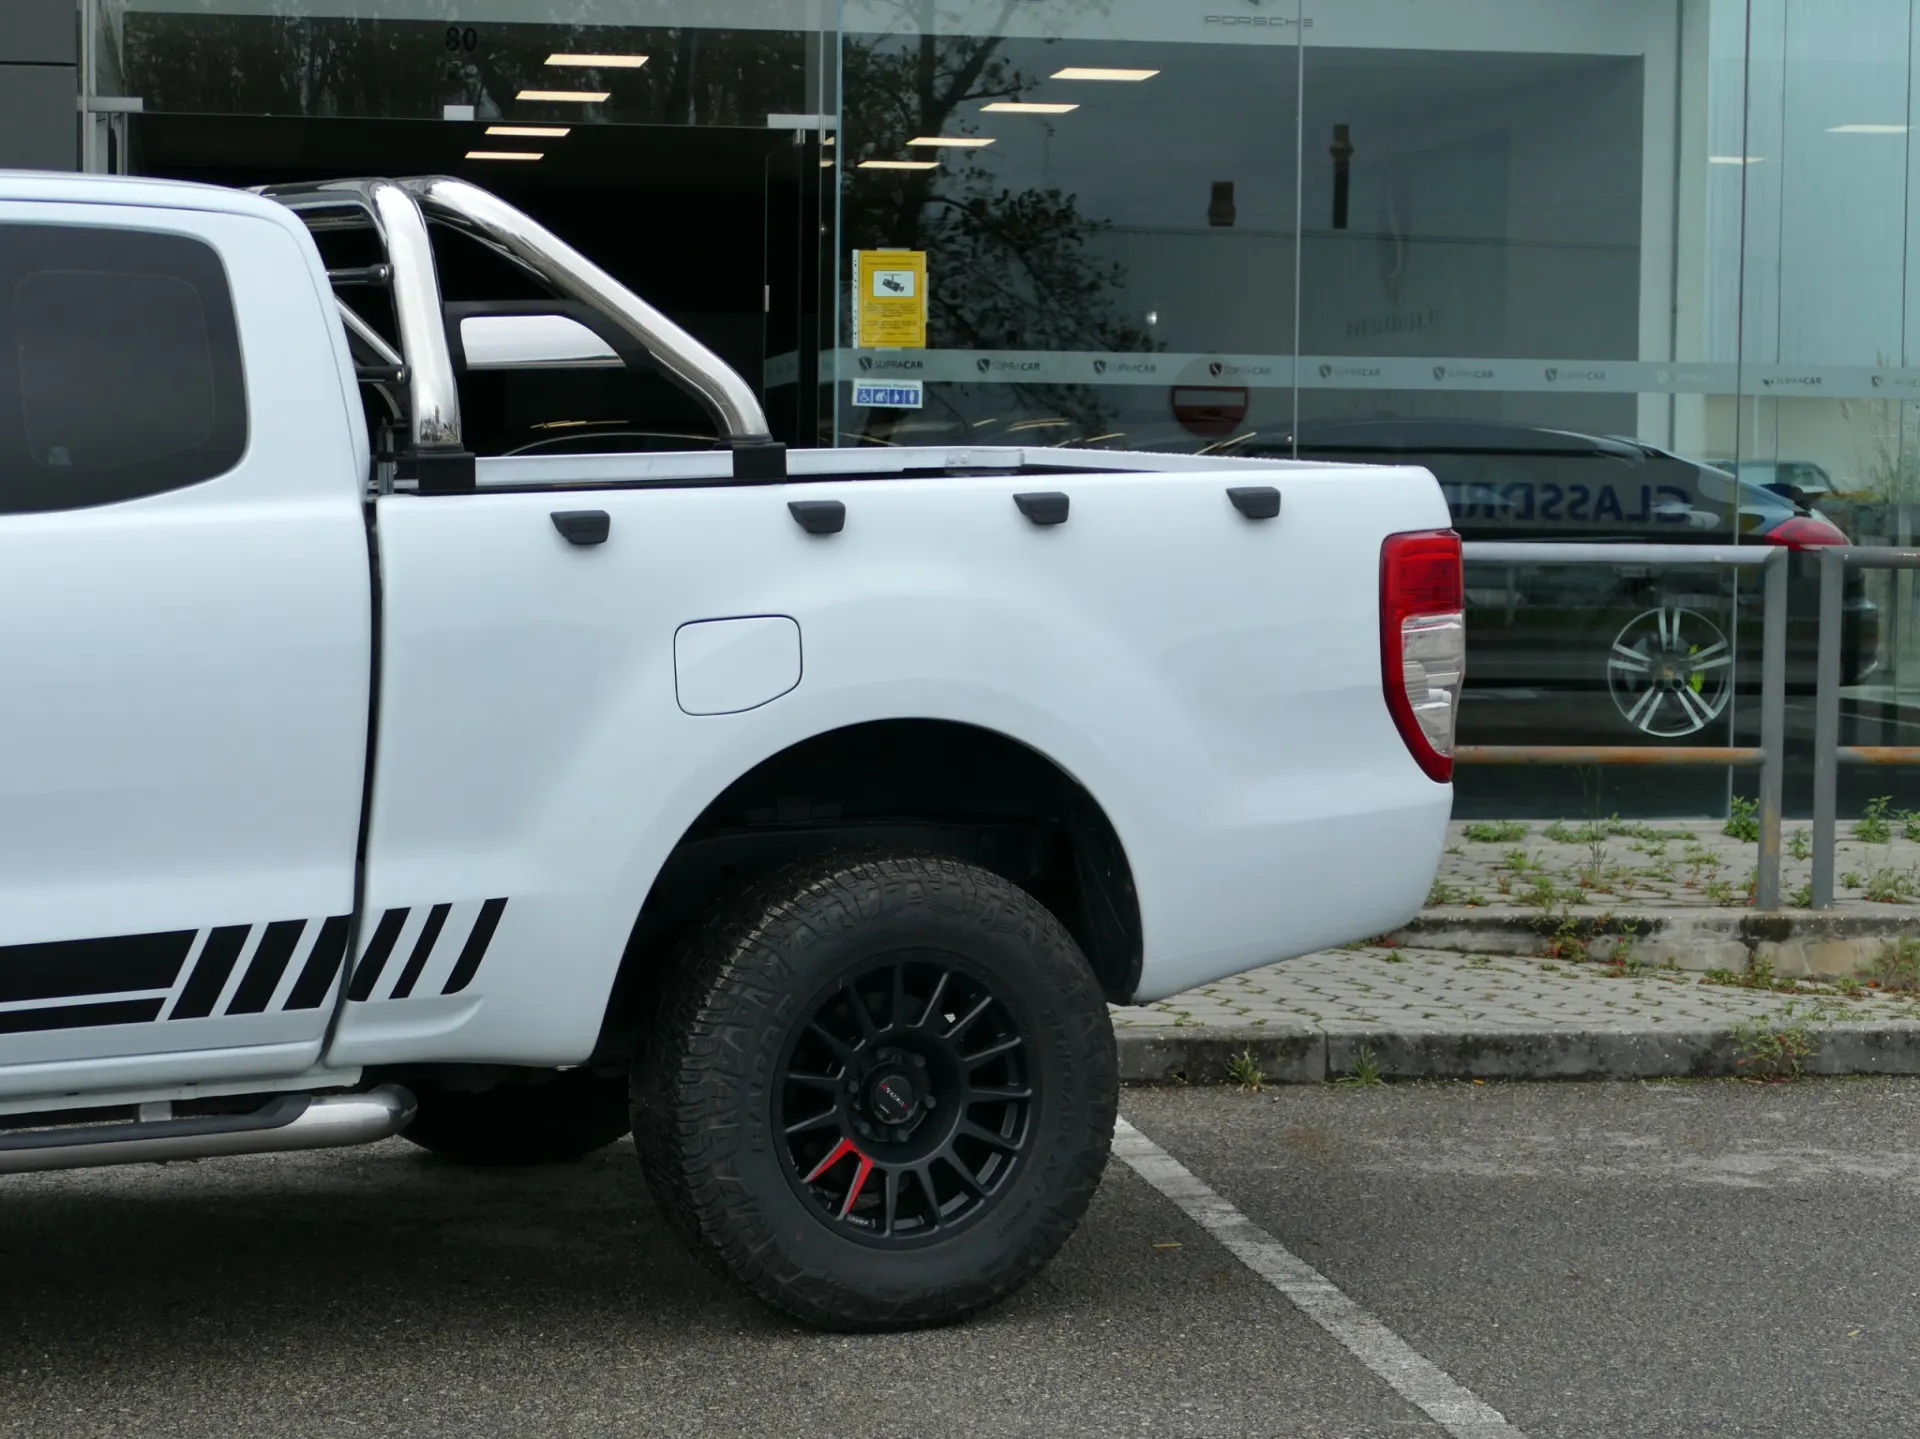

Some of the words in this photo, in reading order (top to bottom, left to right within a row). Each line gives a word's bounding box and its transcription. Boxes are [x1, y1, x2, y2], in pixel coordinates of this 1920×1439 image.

[1204, 15, 1313, 28] PORSCHE
[445, 26, 478, 52] 80
[873, 360, 924, 370] SUPRACAR
[991, 362, 1041, 372] SUPRACAR
